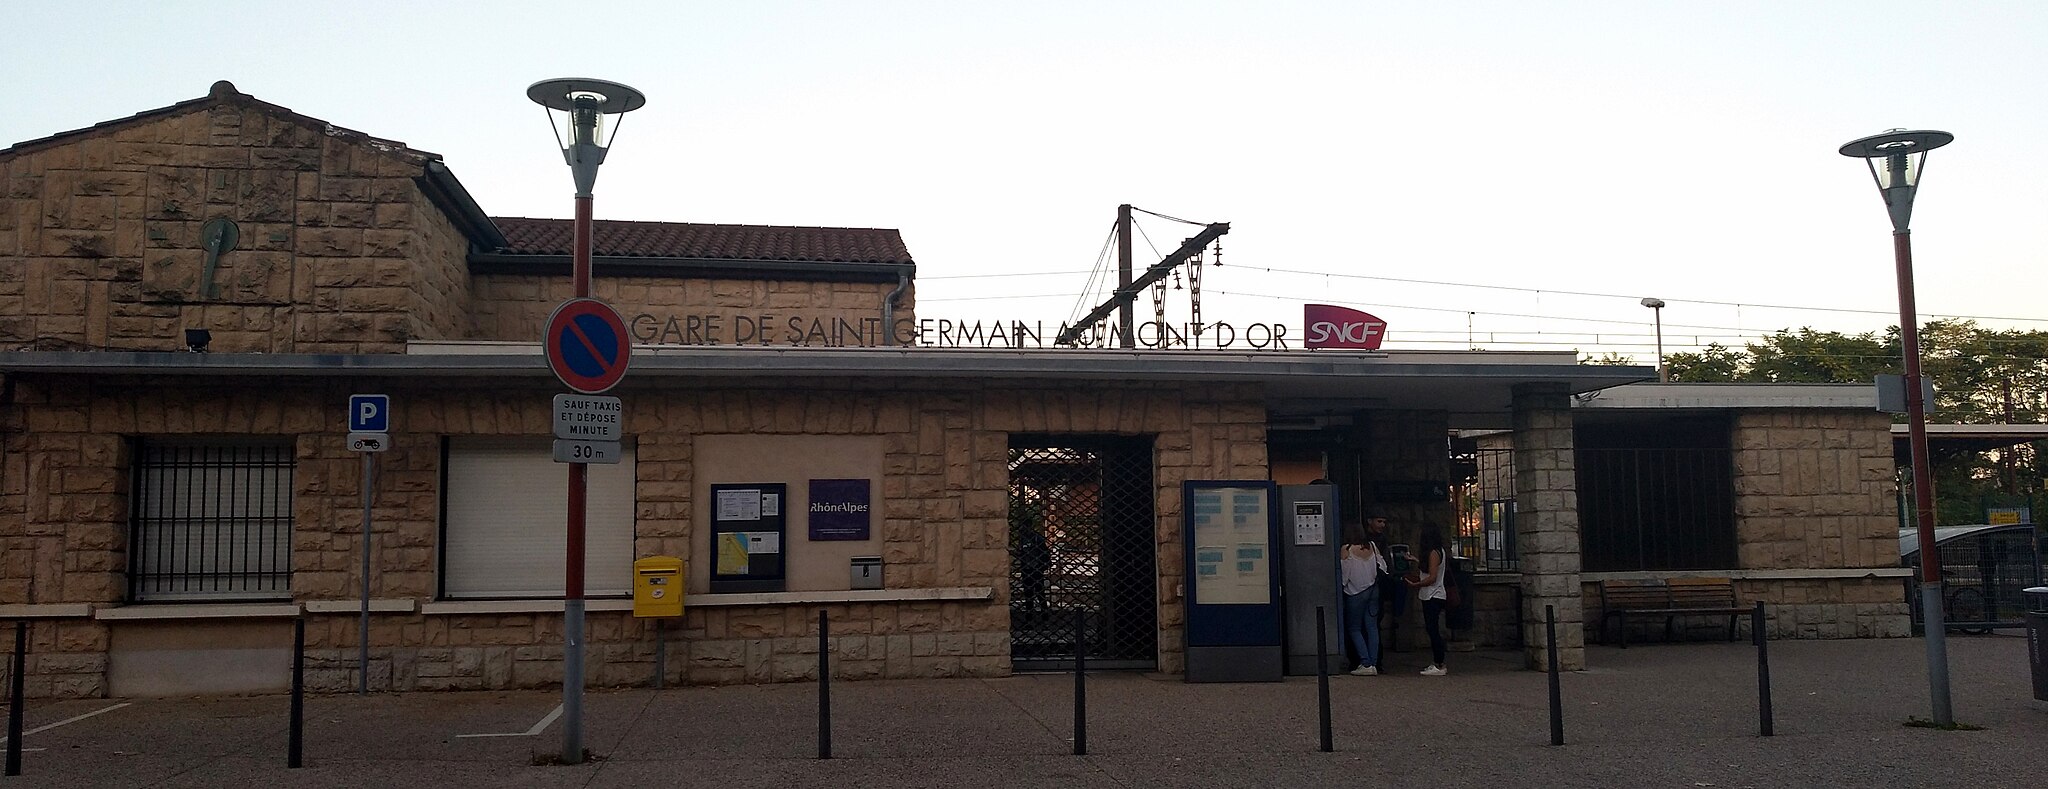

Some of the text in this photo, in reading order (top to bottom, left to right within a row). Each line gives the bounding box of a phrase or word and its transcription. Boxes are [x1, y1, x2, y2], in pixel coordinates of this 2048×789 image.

[631, 314, 721, 343] GARE
[735, 315, 774, 343] DE
[787, 316, 880, 346] SAINT
[893, 318, 1042, 348] GERMAIN
[1246, 322, 1288, 351] OR
[1308, 321, 1383, 343] SNCF
[564, 400, 621, 411] SAUF TAXIS
[360, 402, 377, 425] P
[561, 412, 616, 423] ET DÉPOSE
[569, 425, 608, 436] MINUTE
[573, 445, 604, 459] 30 m
